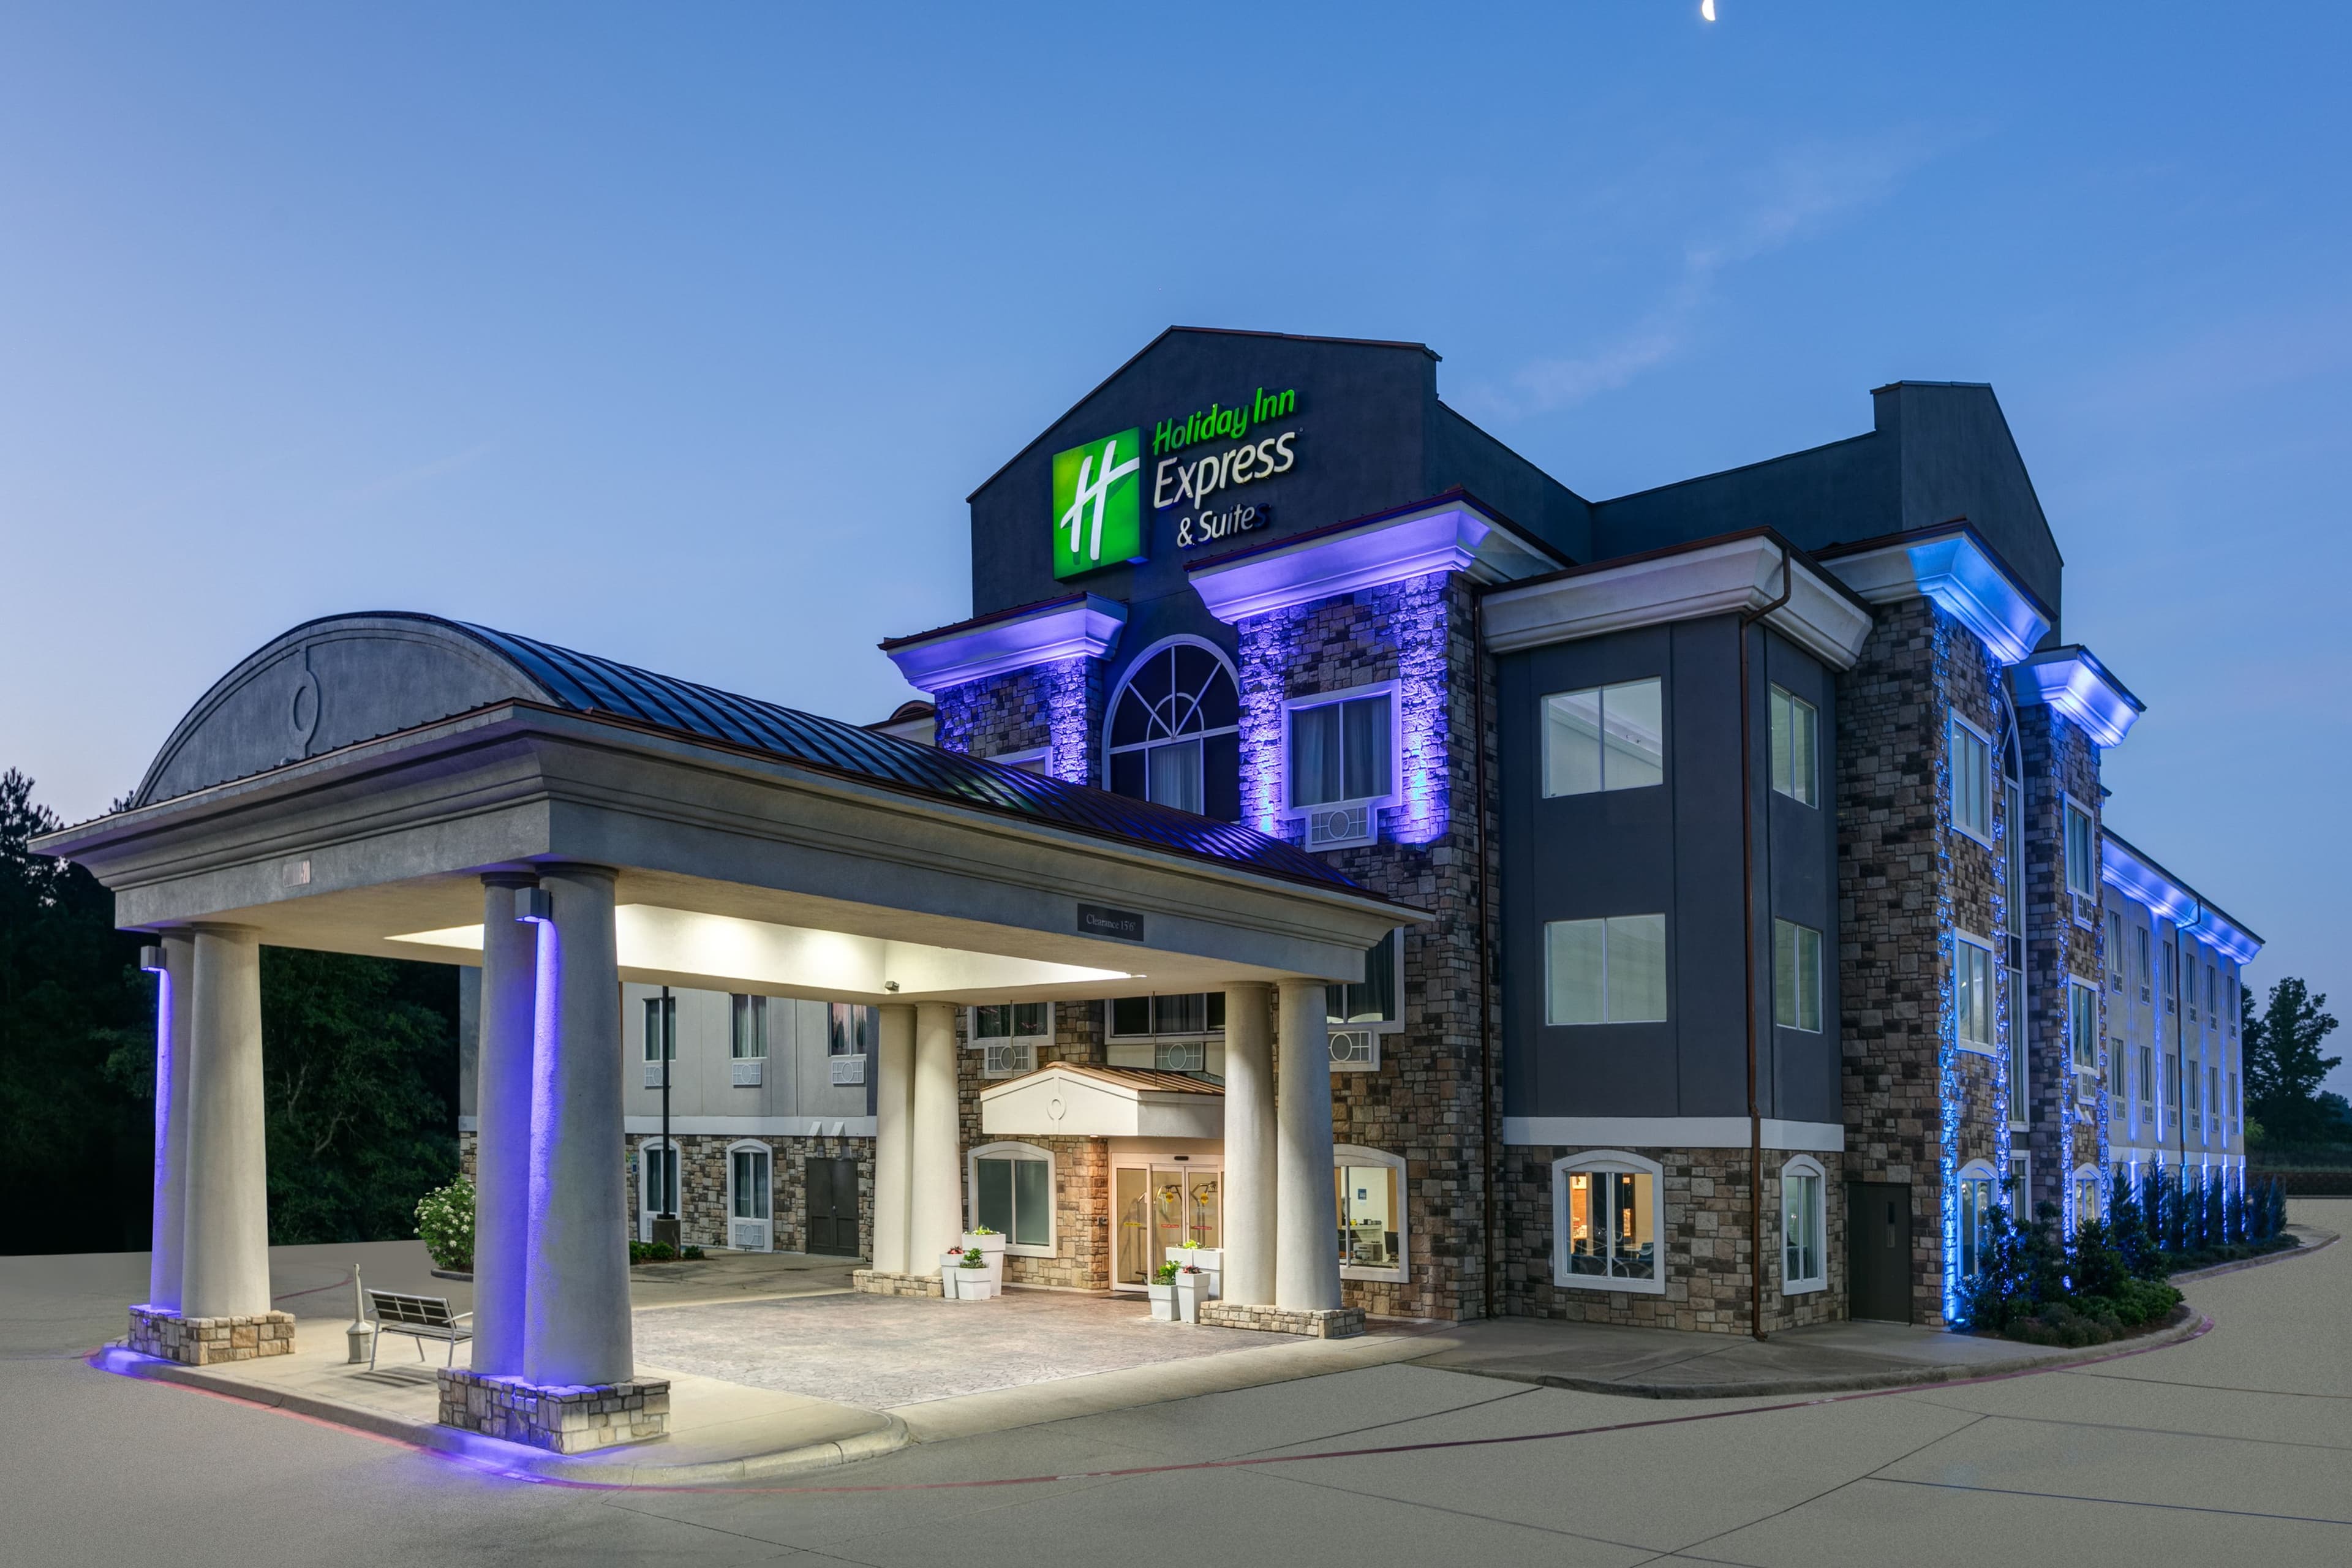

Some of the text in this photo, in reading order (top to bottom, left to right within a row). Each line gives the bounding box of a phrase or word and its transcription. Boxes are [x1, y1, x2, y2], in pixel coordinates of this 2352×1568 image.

[1153, 387, 1295, 456] Holiday Inn
[1153, 431, 1295, 510] Express
[1177, 517, 1194, 548] &
[1086, 913, 1119, 930] Clearance
